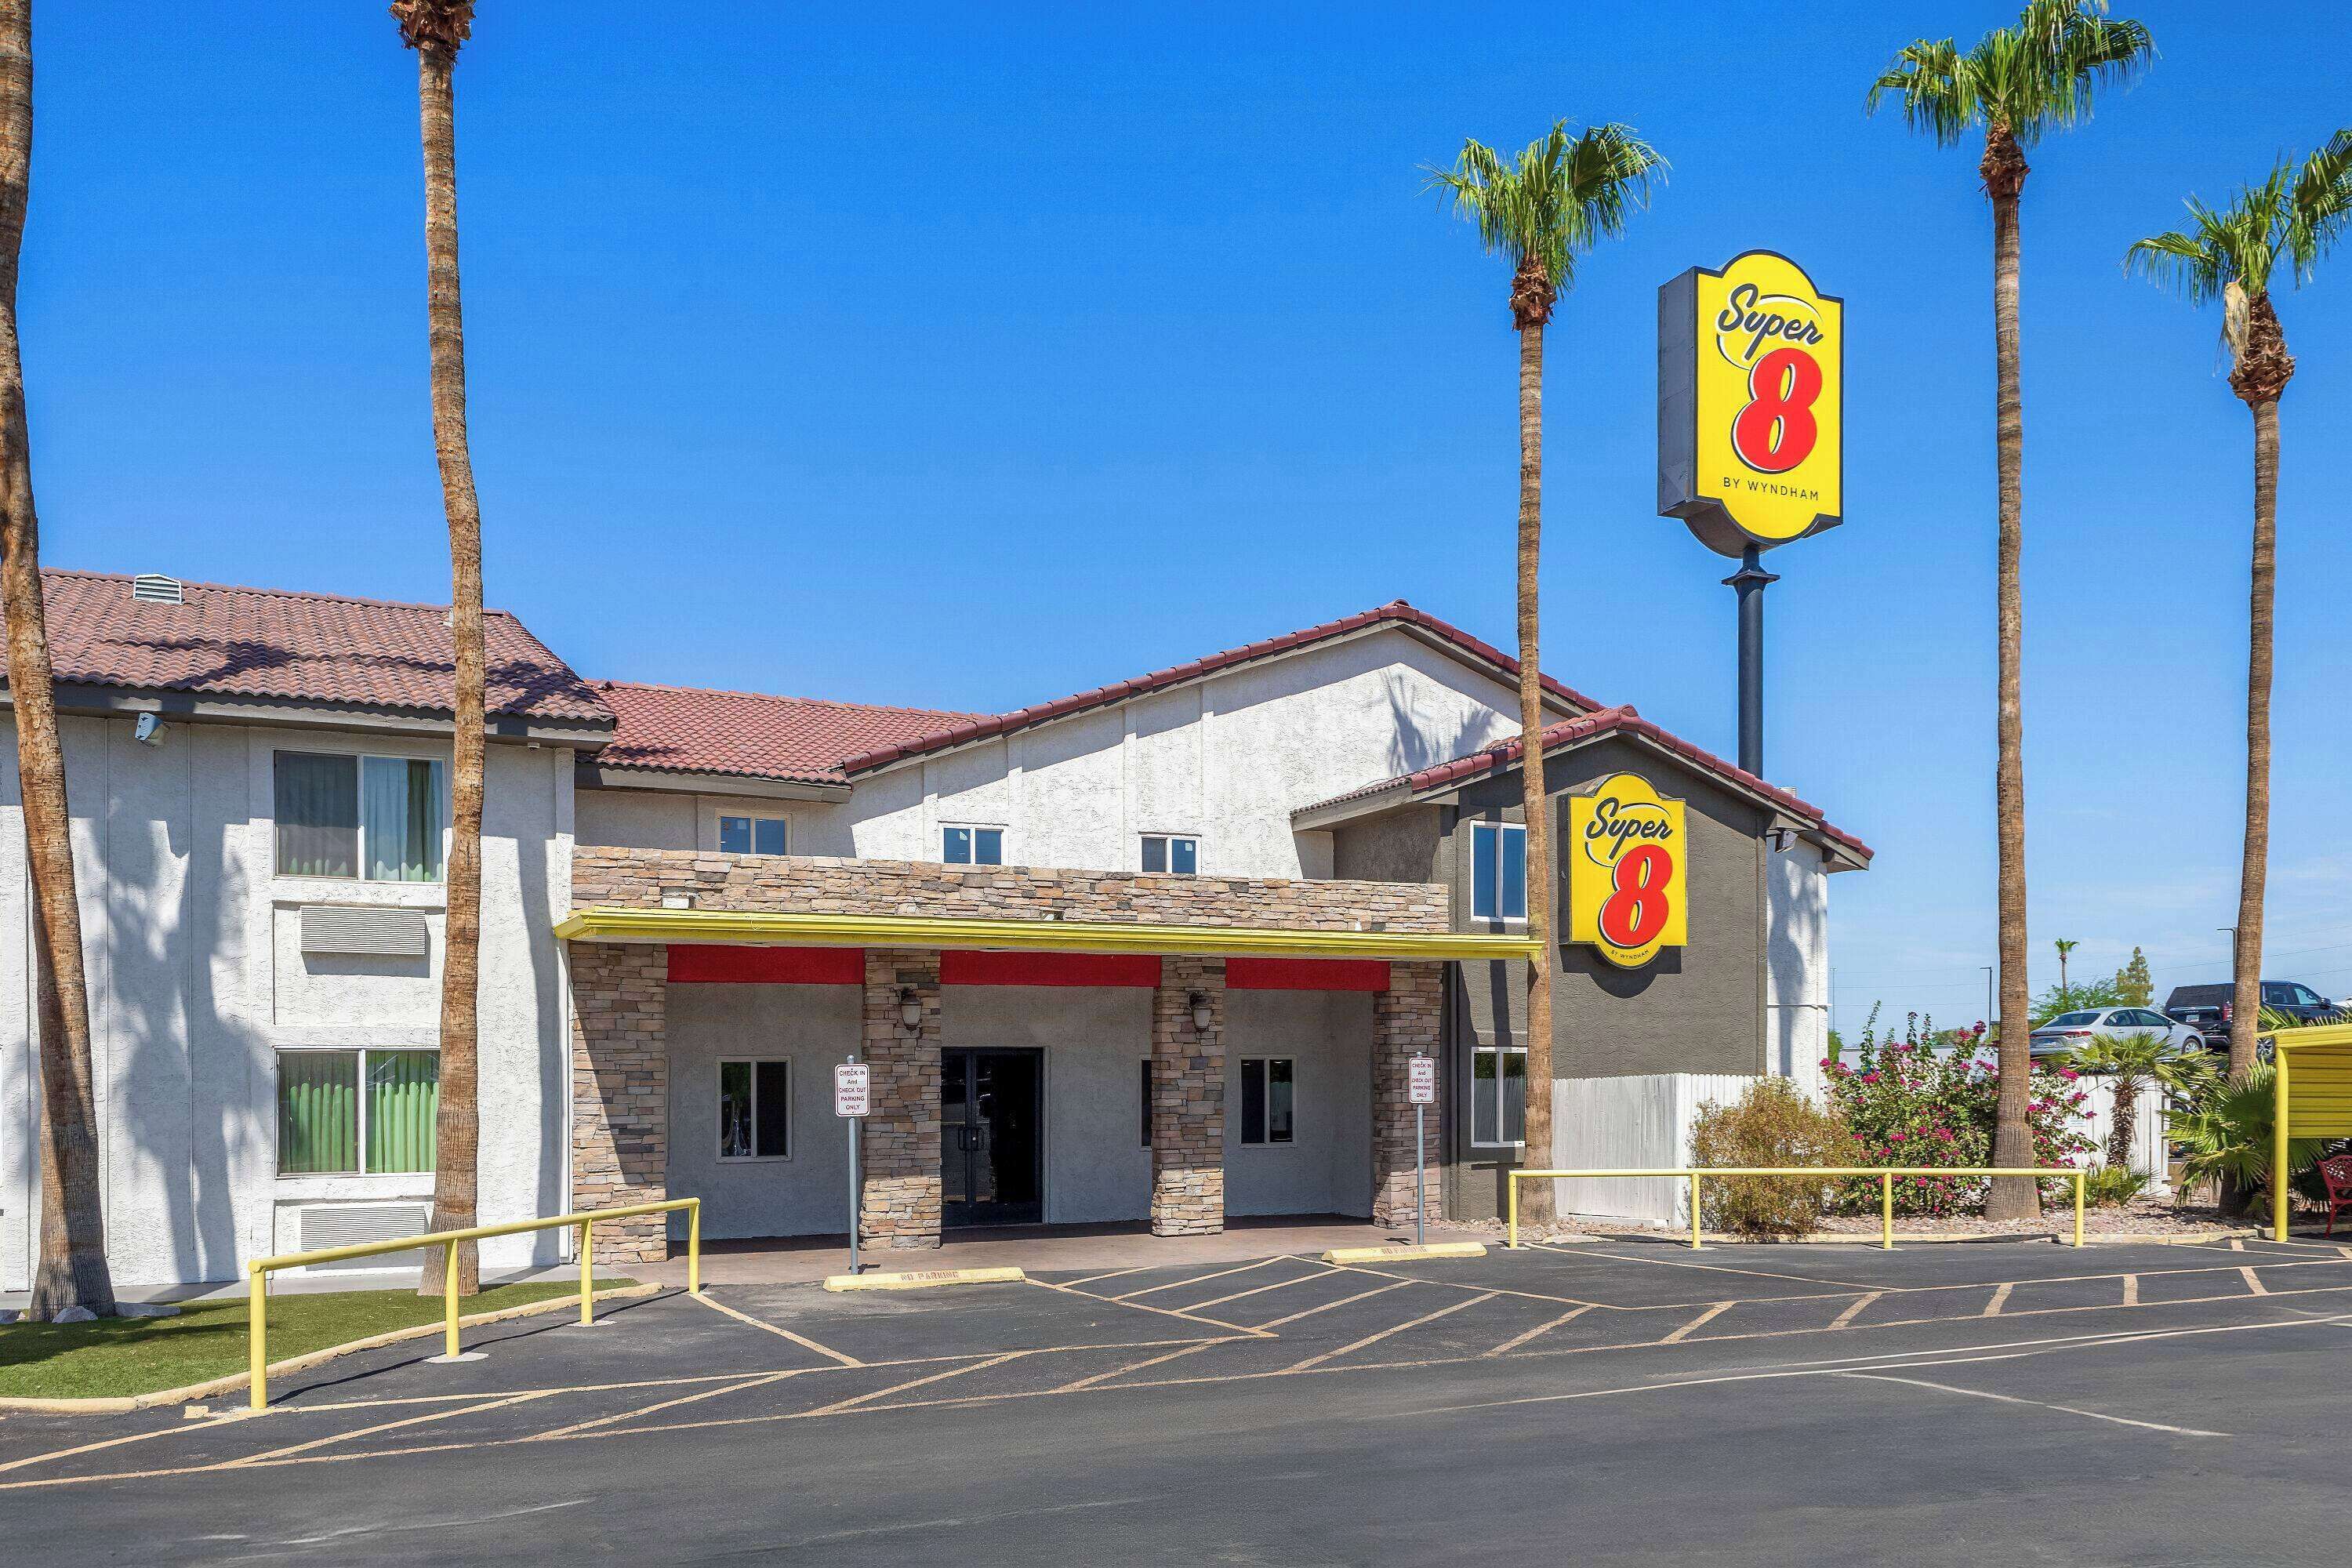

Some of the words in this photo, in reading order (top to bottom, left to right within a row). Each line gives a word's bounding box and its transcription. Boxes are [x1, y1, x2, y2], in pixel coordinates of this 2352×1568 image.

[1717, 283, 1824, 361] Super
[1730, 347, 1823, 474] 8
[1723, 477, 1740, 488] BY
[1748, 480, 1818, 501] WYNDHAM
[1585, 797, 1673, 861] Super
[1598, 844, 1673, 949] 8
[1620, 949, 1650, 960] WYNDHAM
[917, 1271, 959, 1280] PARKING
